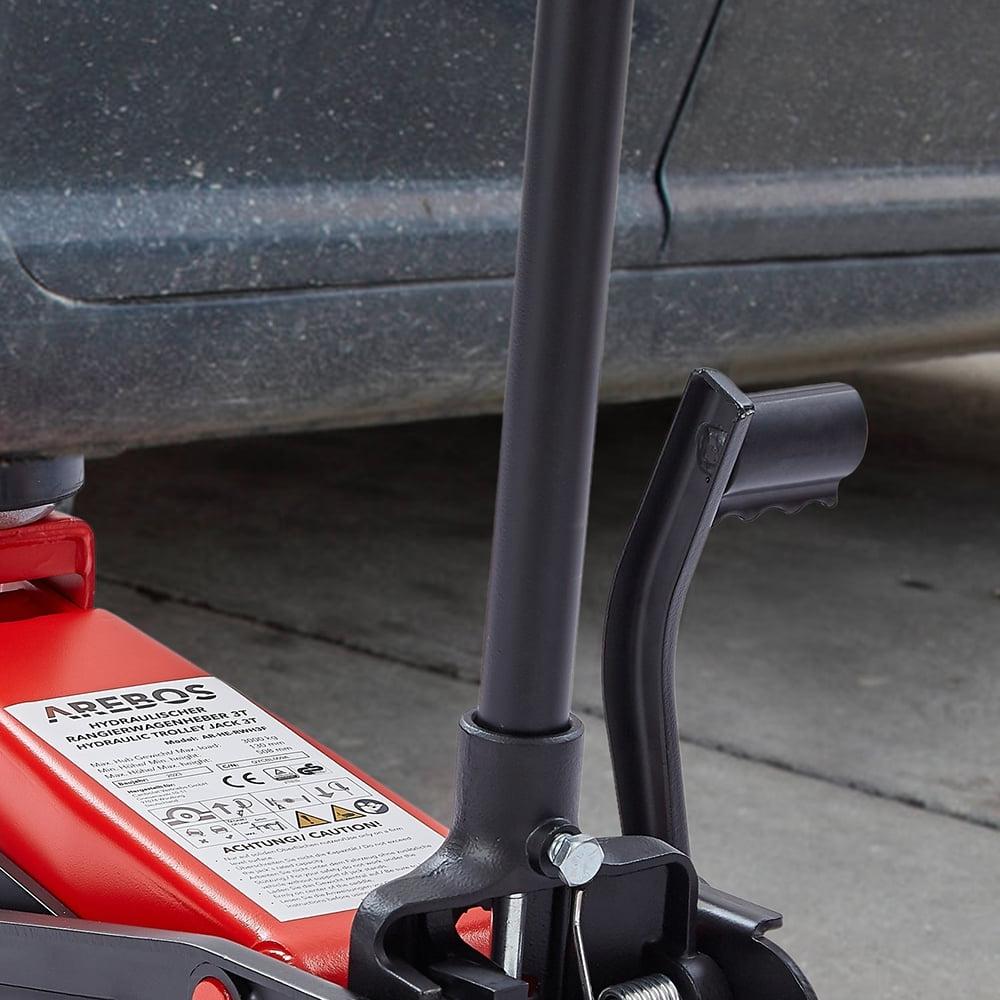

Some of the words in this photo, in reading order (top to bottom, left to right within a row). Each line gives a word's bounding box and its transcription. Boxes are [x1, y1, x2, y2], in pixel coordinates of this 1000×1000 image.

[45, 684, 217, 723] AREBOS
[89, 706, 207, 729] HYDRAULISCHER
[66, 712, 229, 742] RANGIERWAGENHEBER
[231, 709, 248, 717] 3T
[76, 733, 151, 750] HYDRAULIC
[151, 724, 205, 737] TROLLEY
[209, 719, 241, 730] JACK
[241, 717, 258, 725] 3T
[164, 736, 198, 746] Model:
[134, 750, 173, 760] Gewicht/
[240, 736, 265, 744] 3000
[223, 834, 306, 854] ACHTUNG!/
[309, 821, 383, 839] CAUTION!
